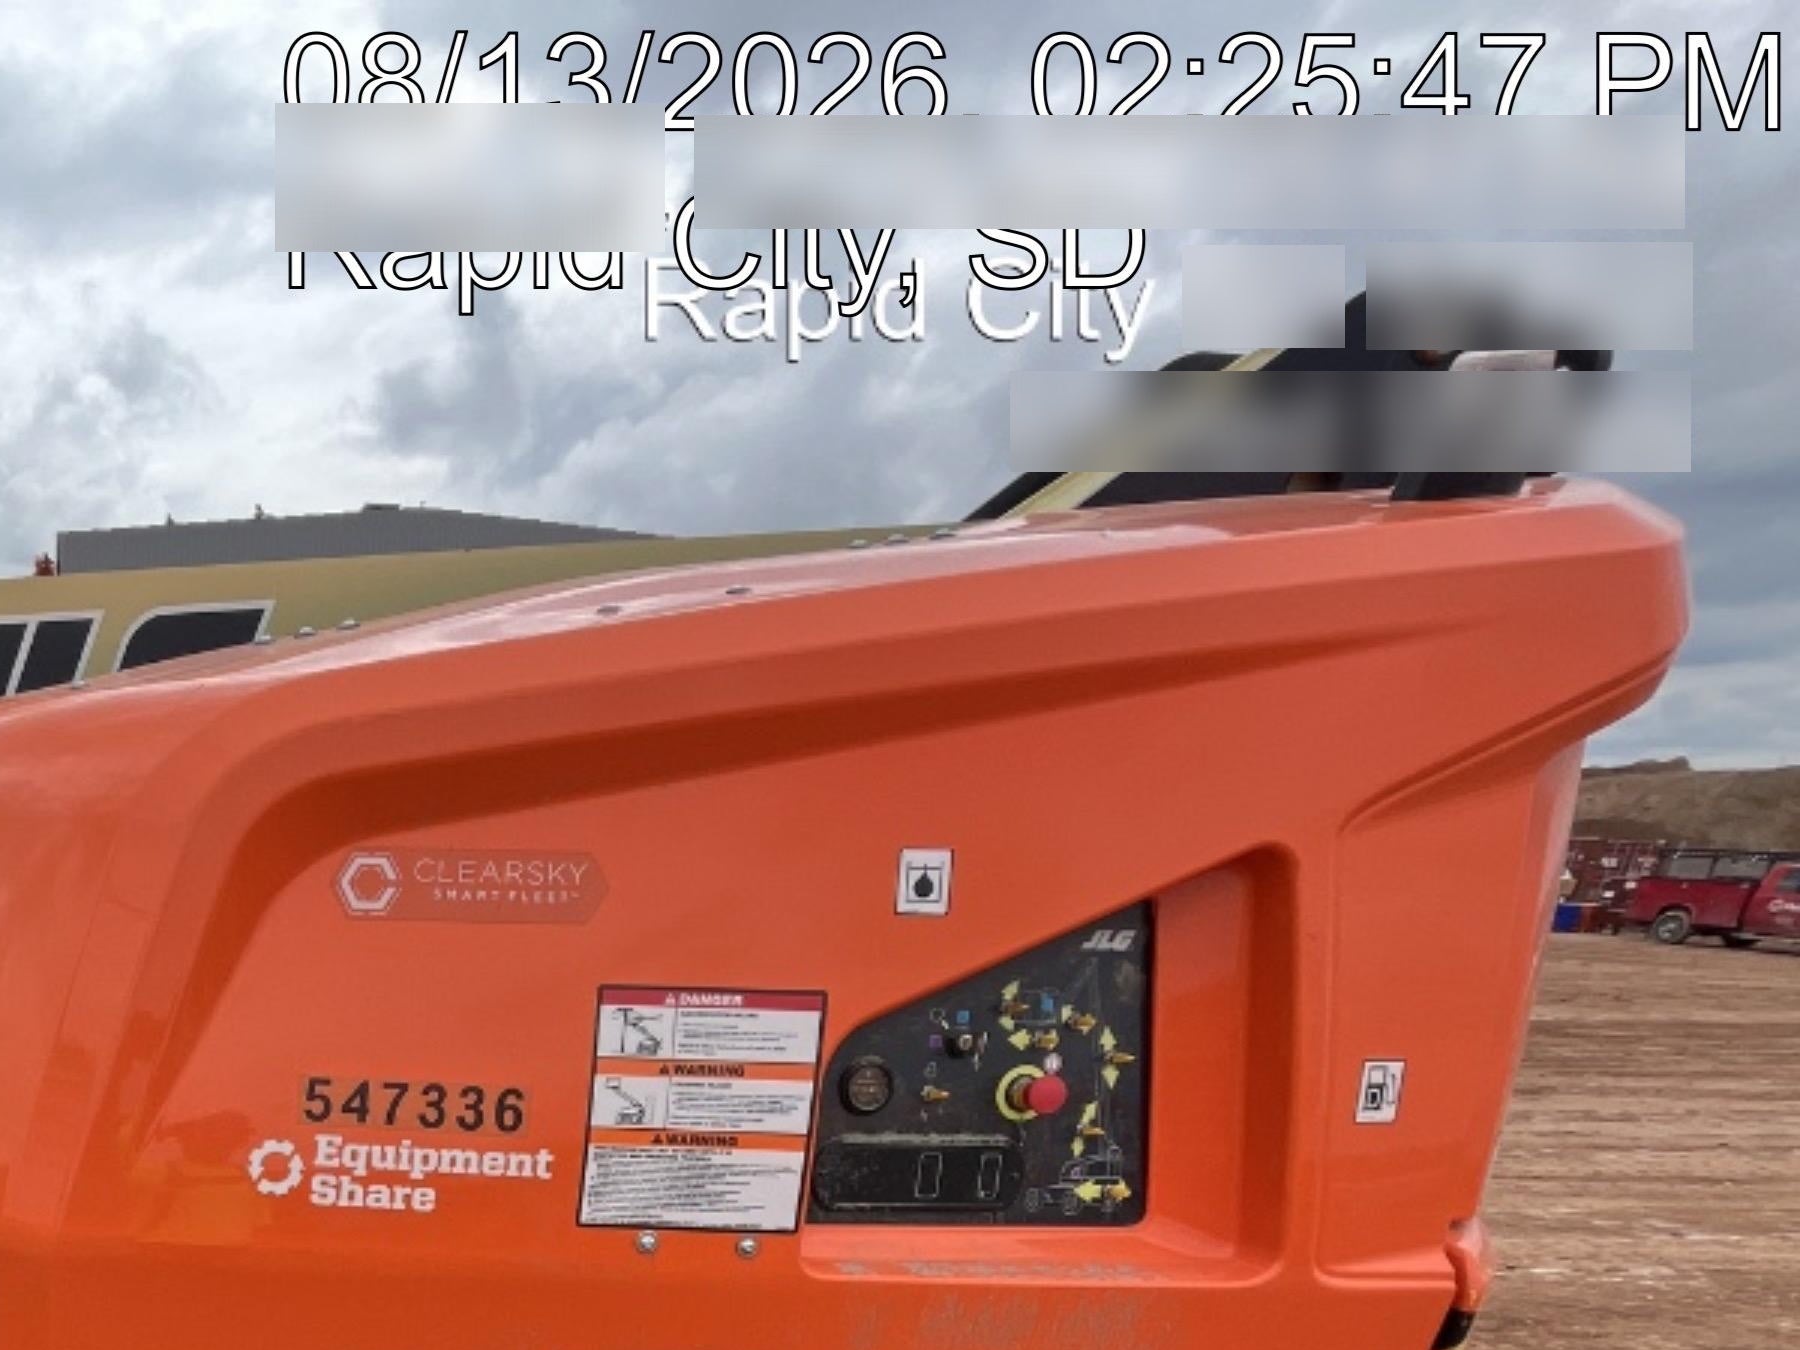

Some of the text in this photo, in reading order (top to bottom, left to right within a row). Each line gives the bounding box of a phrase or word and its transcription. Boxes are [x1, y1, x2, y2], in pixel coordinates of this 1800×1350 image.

[413, 857, 588, 886] CLEARSKY
[1081, 928, 1137, 952] JLG
[679, 991, 743, 1007] DANGER
[673, 1064, 745, 1079] WARNING
[303, 1077, 526, 1133] 547336
[665, 1132, 739, 1148] WARNING
[313, 1135, 555, 1181] Equipment
[309, 1174, 437, 1212] Share
